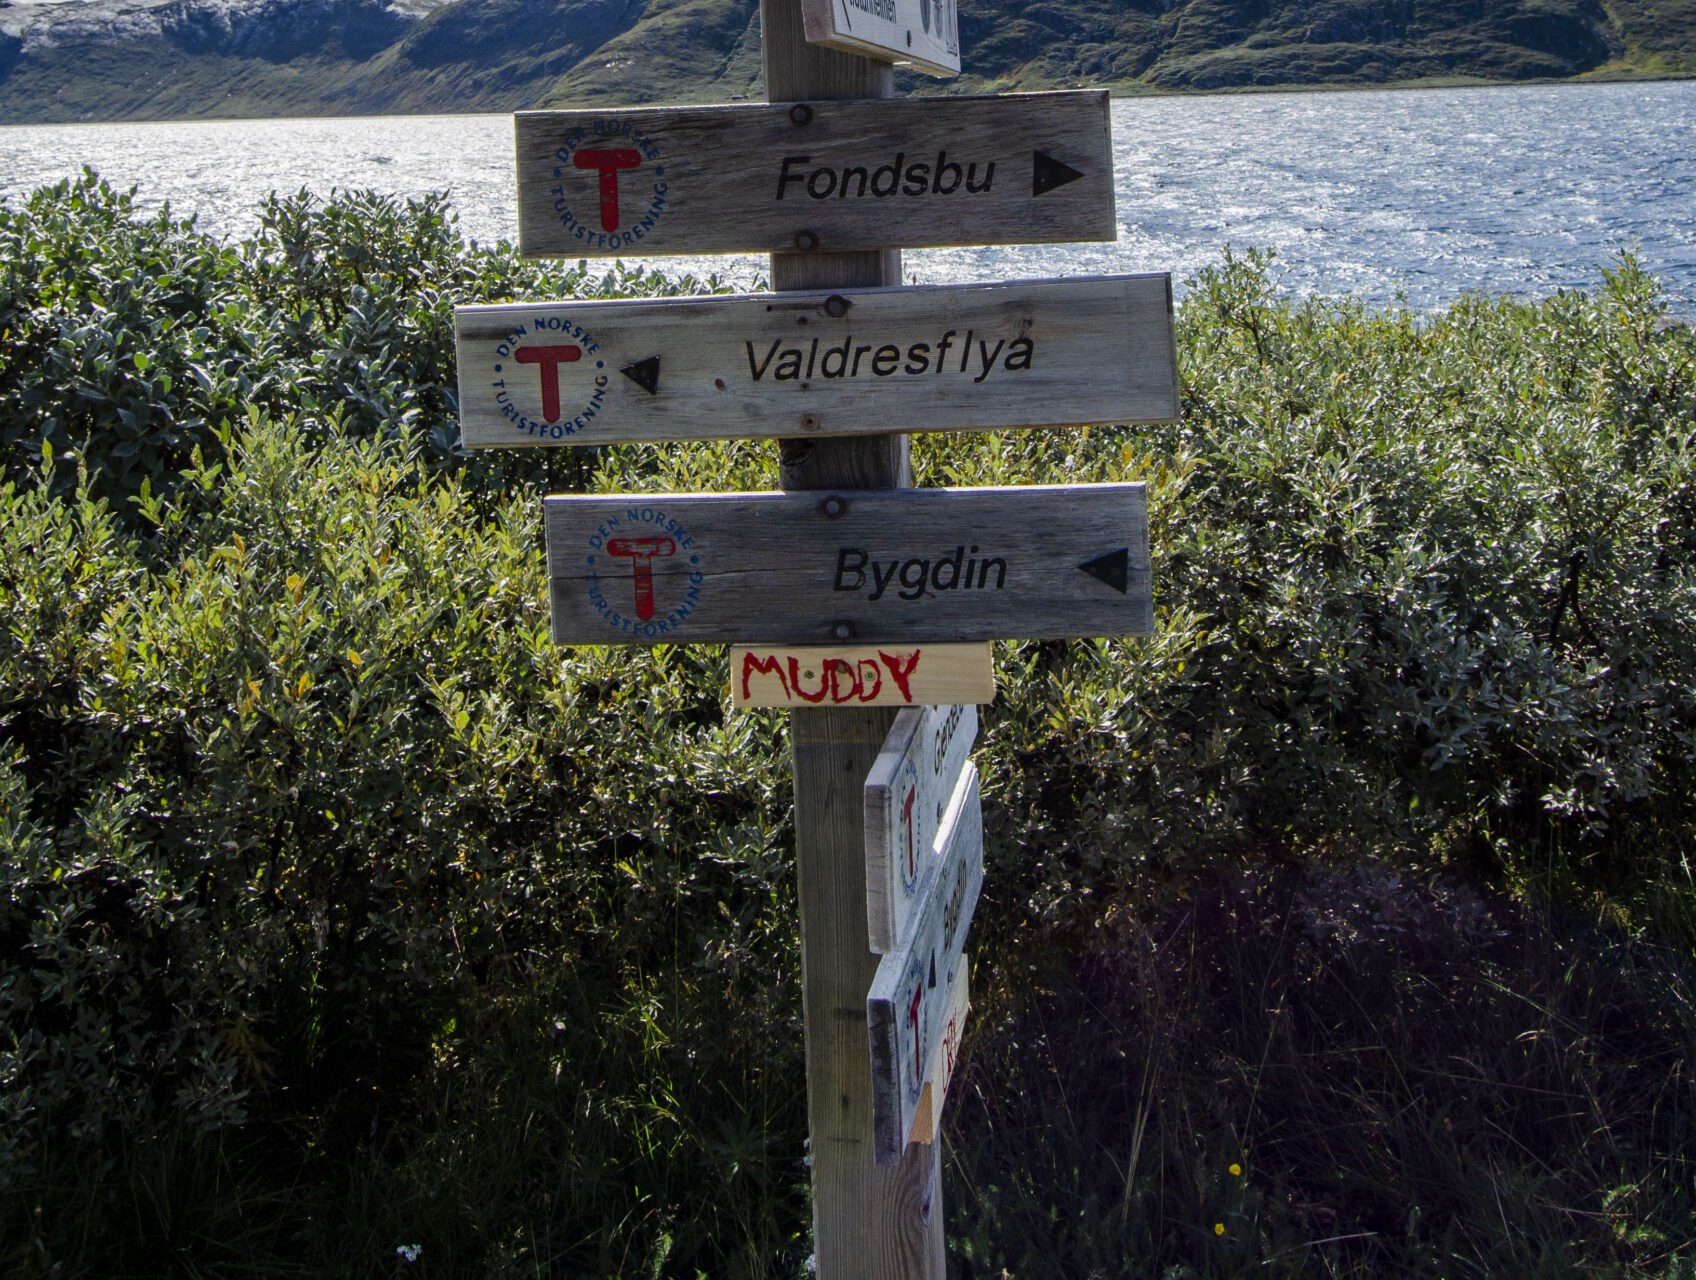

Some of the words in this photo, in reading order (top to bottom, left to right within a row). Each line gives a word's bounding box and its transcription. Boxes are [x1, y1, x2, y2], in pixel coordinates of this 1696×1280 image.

[776, 151, 995, 200] Fondsbu
[551, 182, 668, 249] TURISTFORENING
[496, 324, 528, 357] DEN
[534, 317, 600, 355] NORSKE
[745, 330, 1034, 383] Valdresflya
[492, 375, 608, 439] TURISTFORENING
[588, 516, 620, 549] DEN
[627, 508, 693, 550] NORSKE
[833, 546, 1007, 601] Bygdin
[584, 571, 703, 638] TURISTFORENING
[743, 649, 921, 703] MUDDY
